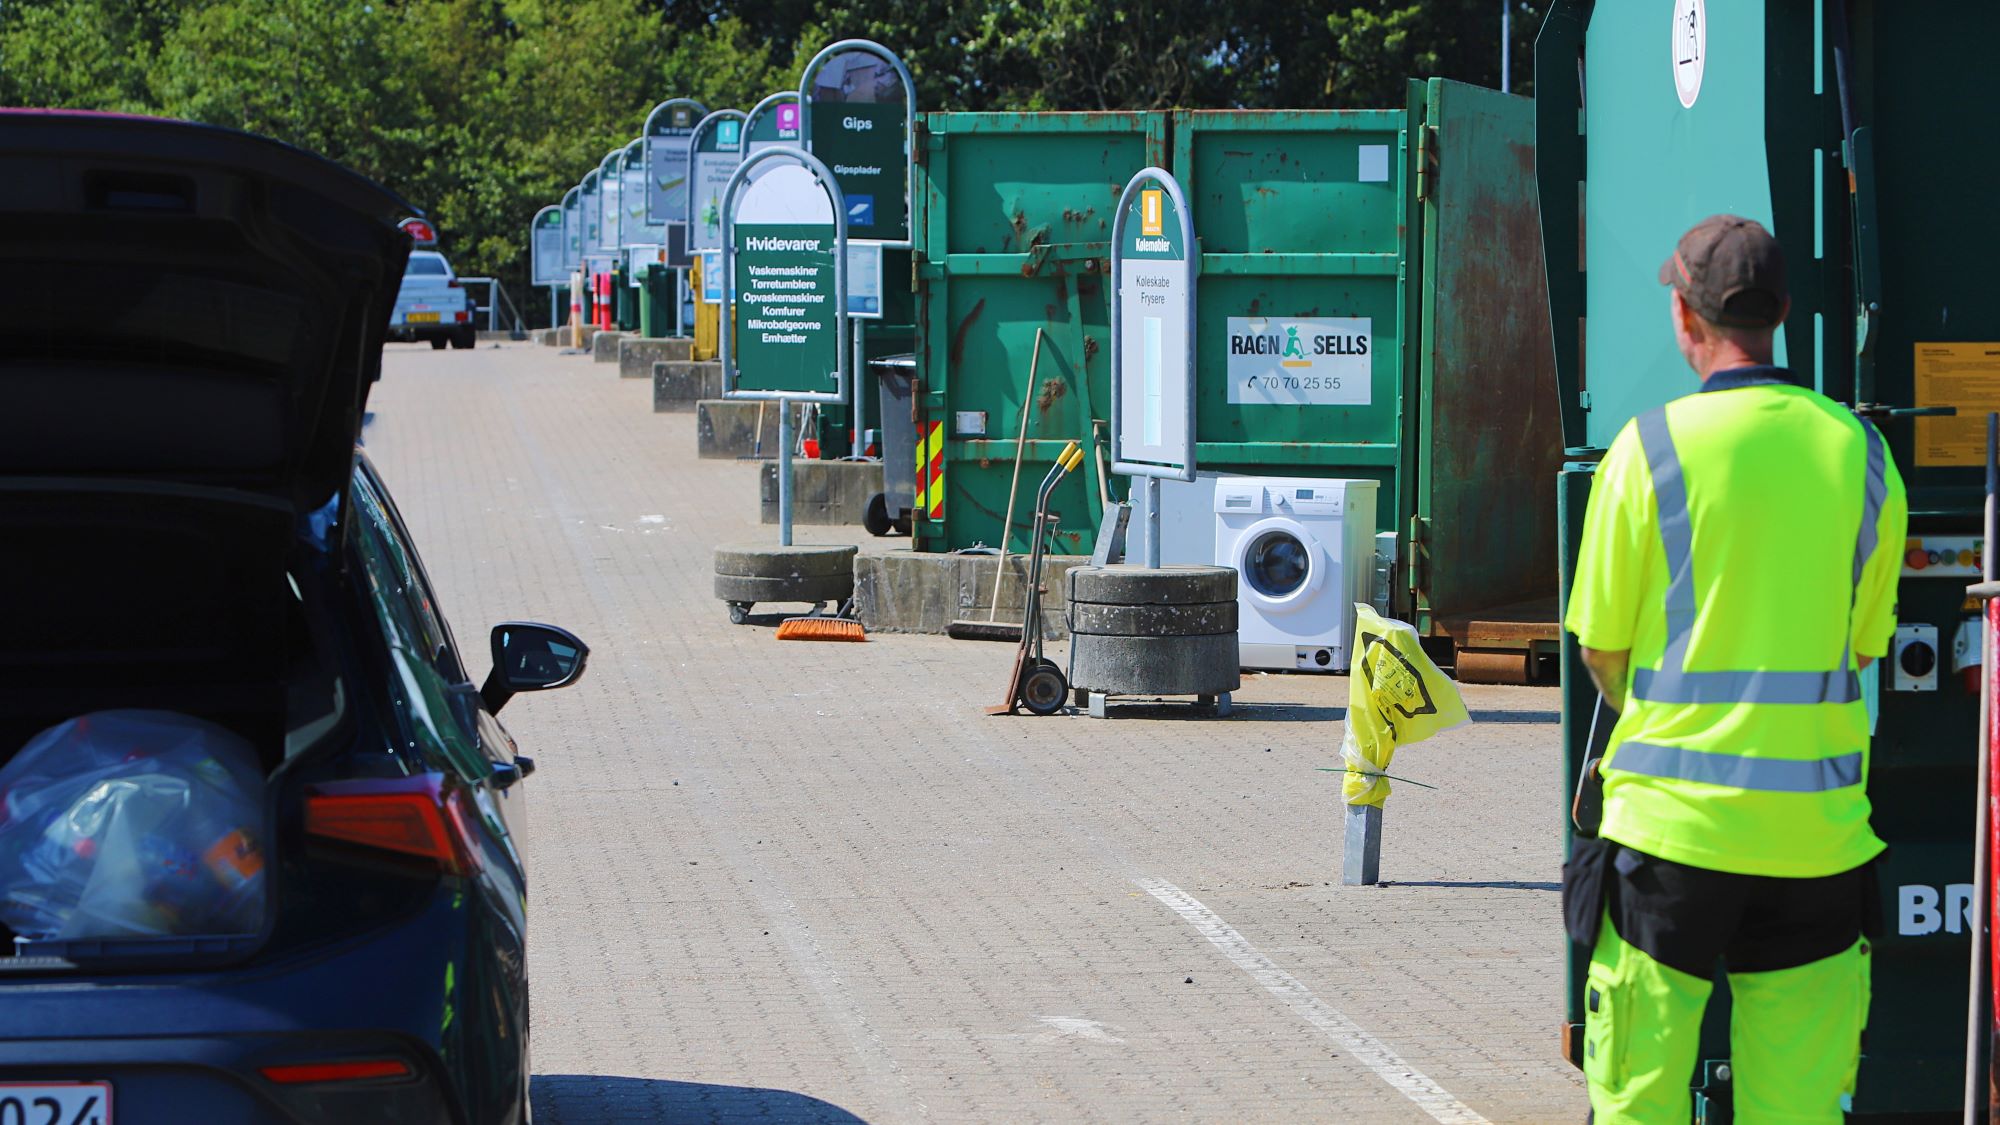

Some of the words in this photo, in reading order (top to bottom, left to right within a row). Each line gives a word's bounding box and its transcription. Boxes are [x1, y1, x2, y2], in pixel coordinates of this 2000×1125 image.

[842, 116, 873, 132] Gips
[834, 164, 882, 176] Gipsplader
[746, 237, 820, 251] Hvidevarer
[1136, 238, 1170, 252] Kølemøbler
[748, 266, 818, 276] Vaskemaskiner
[751, 280, 816, 289] Tørretumblere
[1136, 275, 1170, 288] Køleskabe
[743, 292, 825, 304] Opvaskemaskiner
[1140, 292, 1165, 306] Frysere
[762, 306, 806, 316] Komfurer
[748, 320, 821, 332] Mikrobølgeovne
[762, 333, 807, 343] Emhætter
[1232, 335, 1280, 355] RAGN
[1314, 335, 1368, 355] SELLS
[1263, 377, 1279, 389] 70
[1283, 377, 1299, 389] 70
[1304, 377, 1320, 389] 25
[1324, 377, 1341, 389] 55
